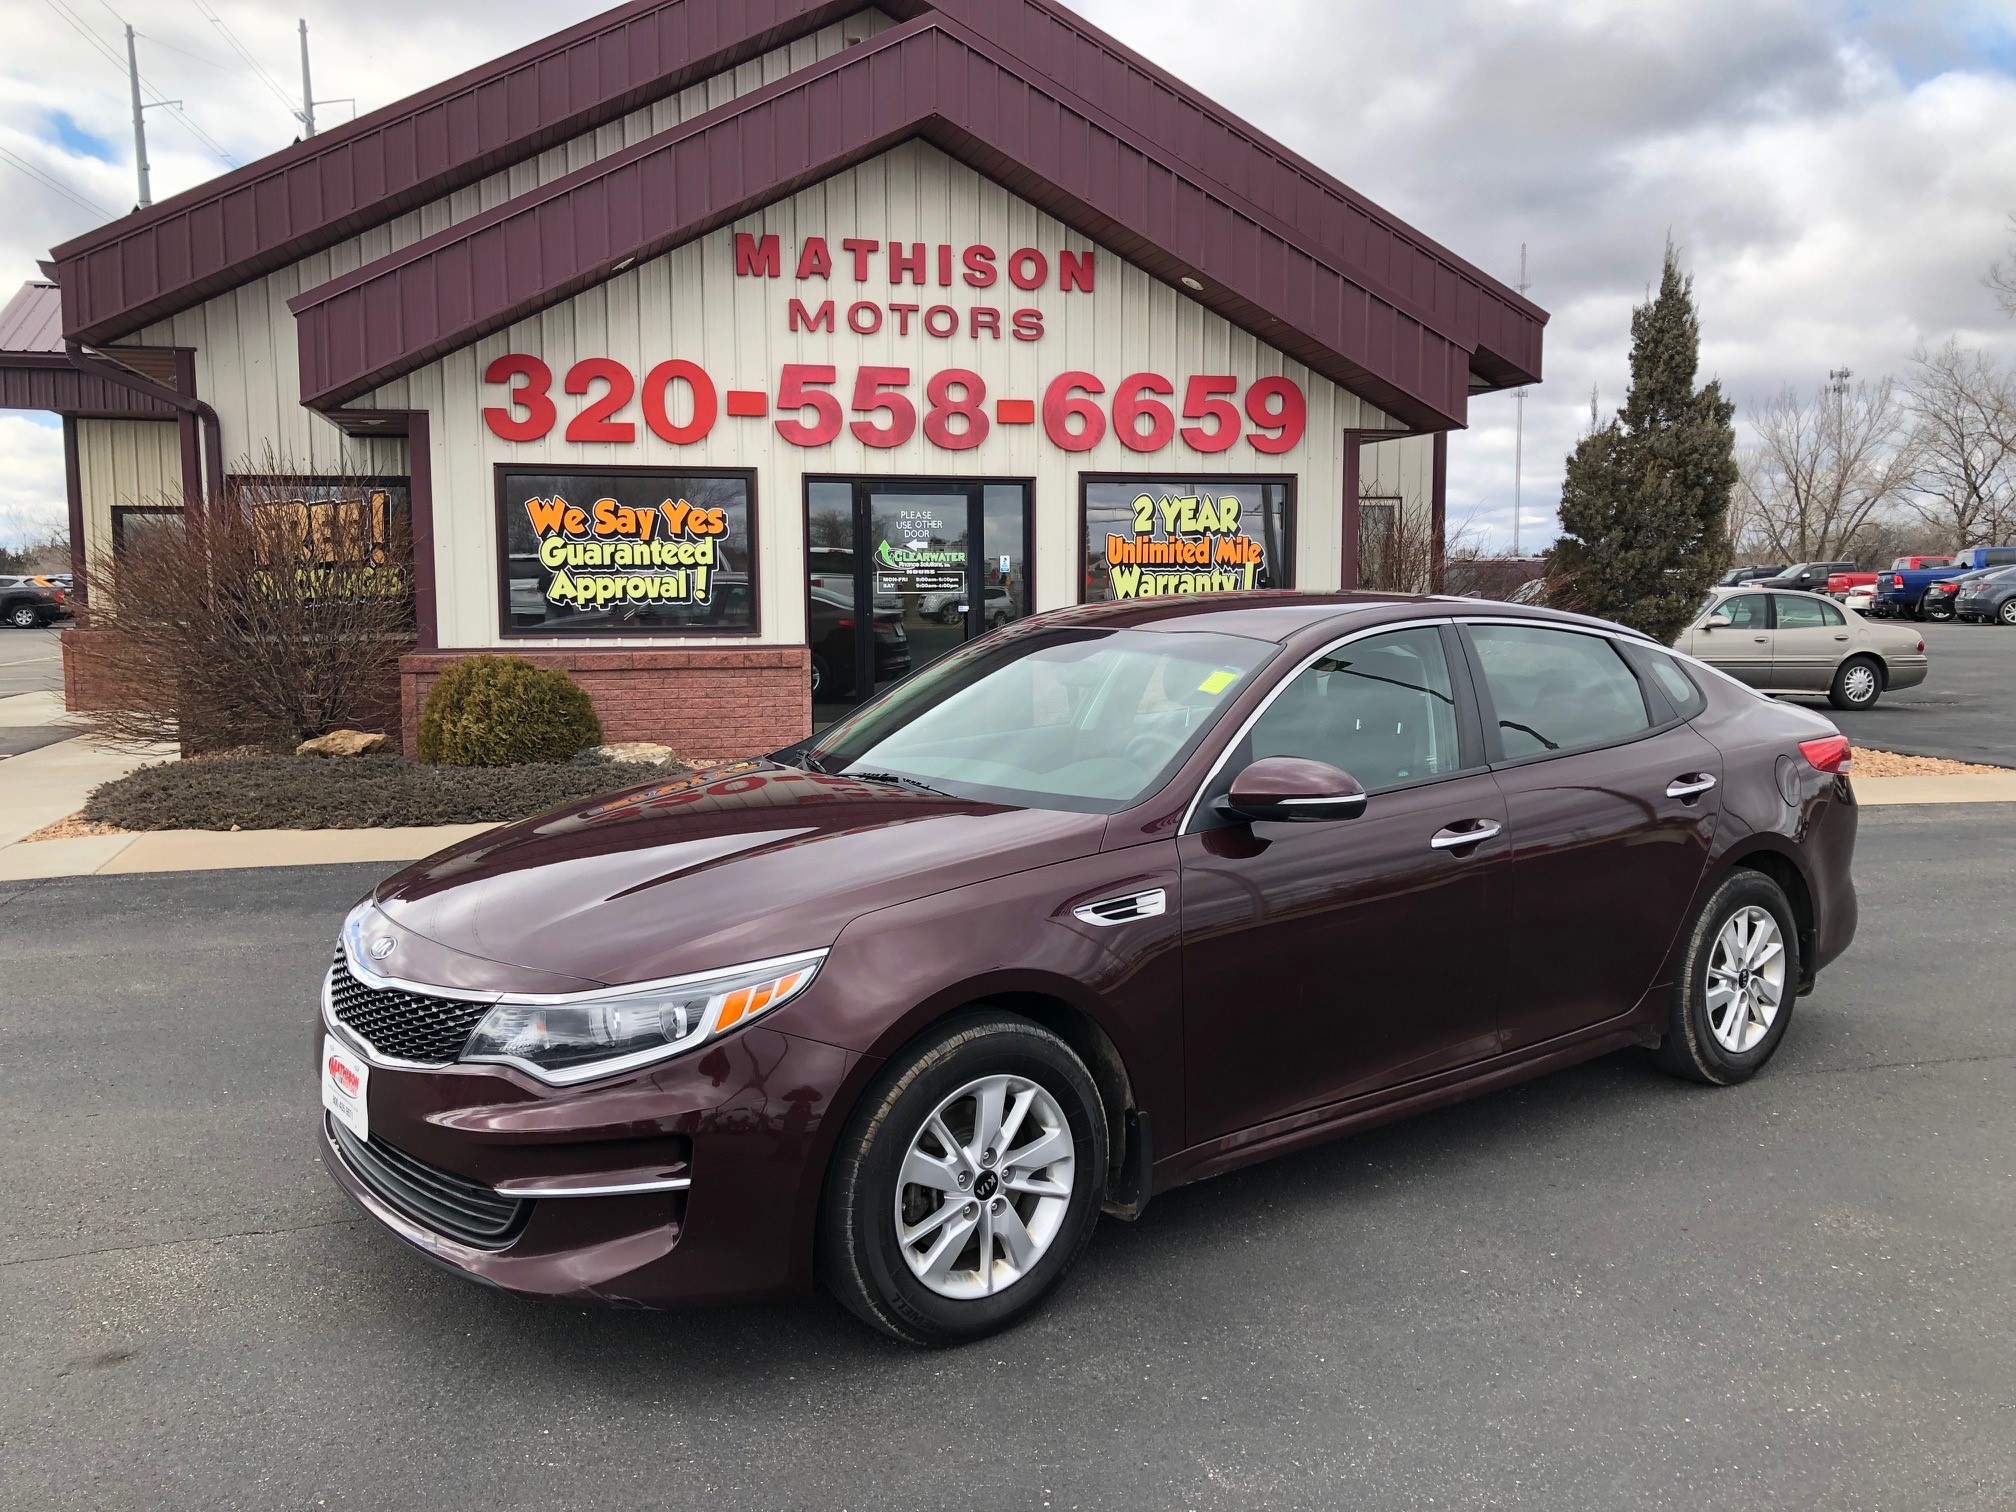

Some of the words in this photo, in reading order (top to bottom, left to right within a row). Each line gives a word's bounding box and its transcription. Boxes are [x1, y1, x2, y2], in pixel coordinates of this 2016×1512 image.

[735, 233, 1094, 293] MATHISON
[789, 298, 1045, 341] MOTORS
[484, 353, 1307, 454] 320-558-6659
[526, 496, 587, 536] We
[594, 499, 656, 541] Say
[660, 499, 725, 535] Yes
[896, 521, 912, 529] USE
[915, 520, 943, 529] OTHER
[900, 511, 932, 520] PLEASE
[1132, 494, 1156, 533] 2
[1158, 494, 1243, 533] YEAR
[904, 529, 930, 538] DOOR
[540, 536, 714, 567] Guaranteed
[894, 550, 966, 562] CLEARWATER
[1106, 534, 1211, 564] Unlimited
[1214, 534, 1263, 564] Mile
[976, 1174, 997, 1196] KIA
